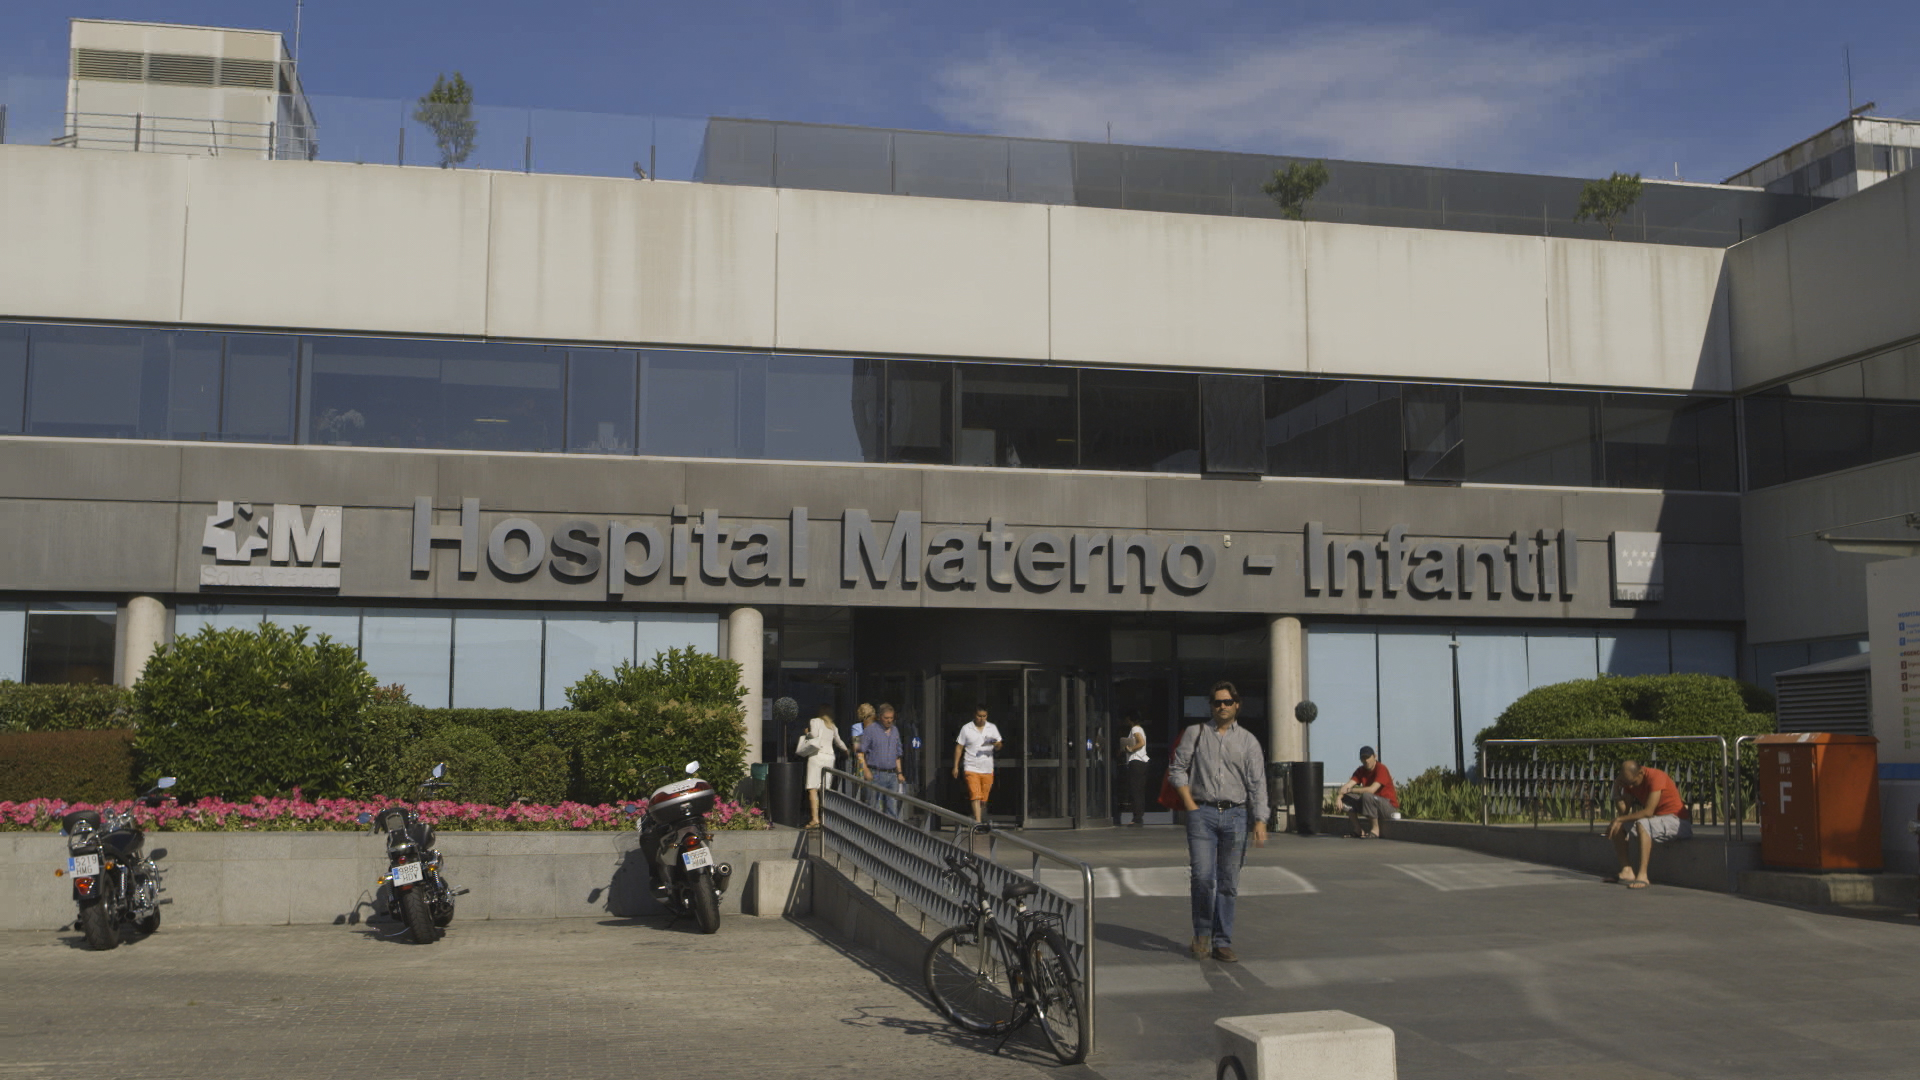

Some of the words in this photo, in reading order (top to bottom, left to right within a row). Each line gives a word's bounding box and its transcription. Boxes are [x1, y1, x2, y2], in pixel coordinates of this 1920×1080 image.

[412, 495, 809, 595] Hospital
[841, 507, 1217, 591] Materno
[1305, 520, 1579, 596] Infantil
[1779, 781, 1793, 815] F
[75, 855, 97, 867] 5219
